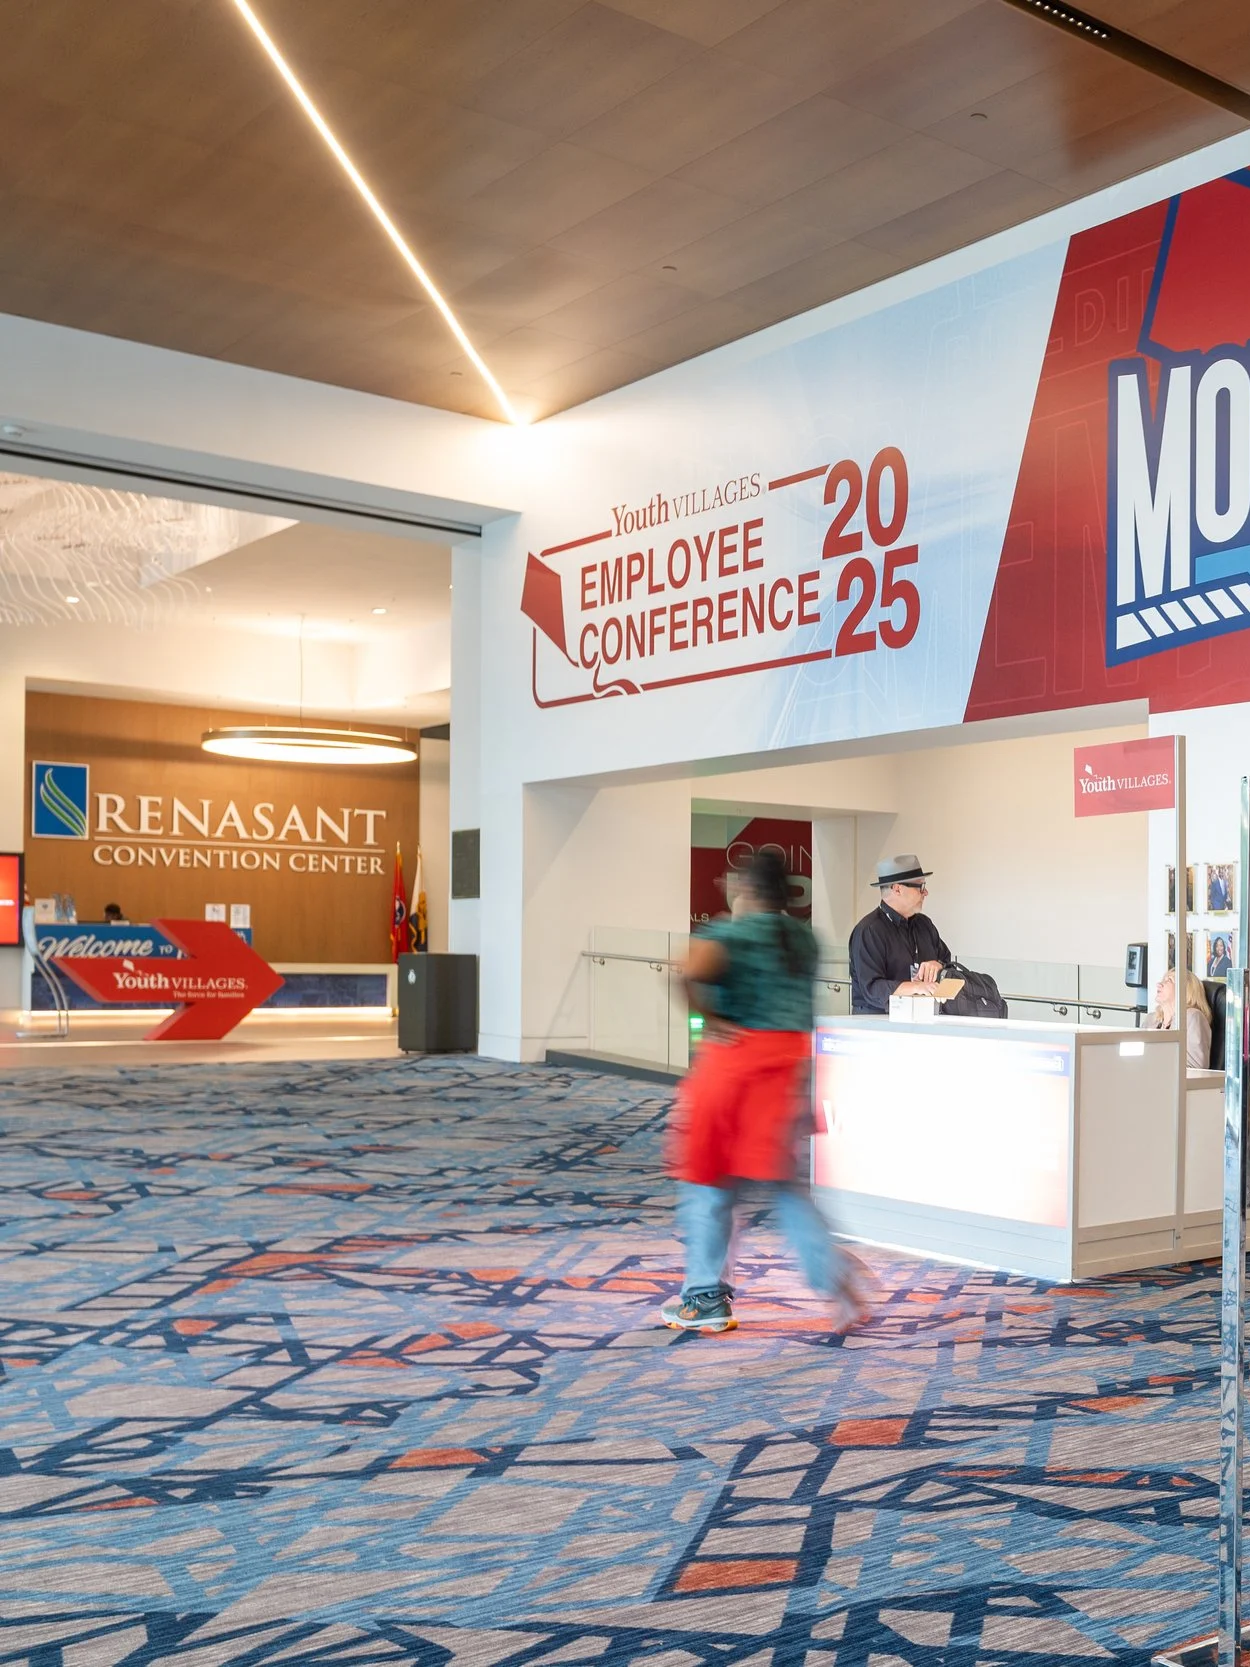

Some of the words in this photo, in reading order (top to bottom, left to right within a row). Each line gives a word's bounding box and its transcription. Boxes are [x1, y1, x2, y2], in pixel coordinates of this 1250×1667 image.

[612, 493, 670, 537] Youth
[672, 472, 762, 520] VILLAGES
[822, 446, 909, 560] 20
[580, 517, 764, 611] EMPLOYEE
[579, 570, 821, 669] CONFERENCE
[835, 544, 921, 657] 25
[1079, 775, 1116, 793] Youth
[1117, 773, 1169, 790] VILLAGES
[94, 792, 386, 846] RENASANT
[93, 844, 281, 871] CONVENTION
[289, 853, 386, 875] CENTER
[39, 934, 153, 961] Welcome
[159, 945, 174, 954] TO
[113, 972, 170, 989] Youth
[172, 977, 245, 990] VILLAGES
